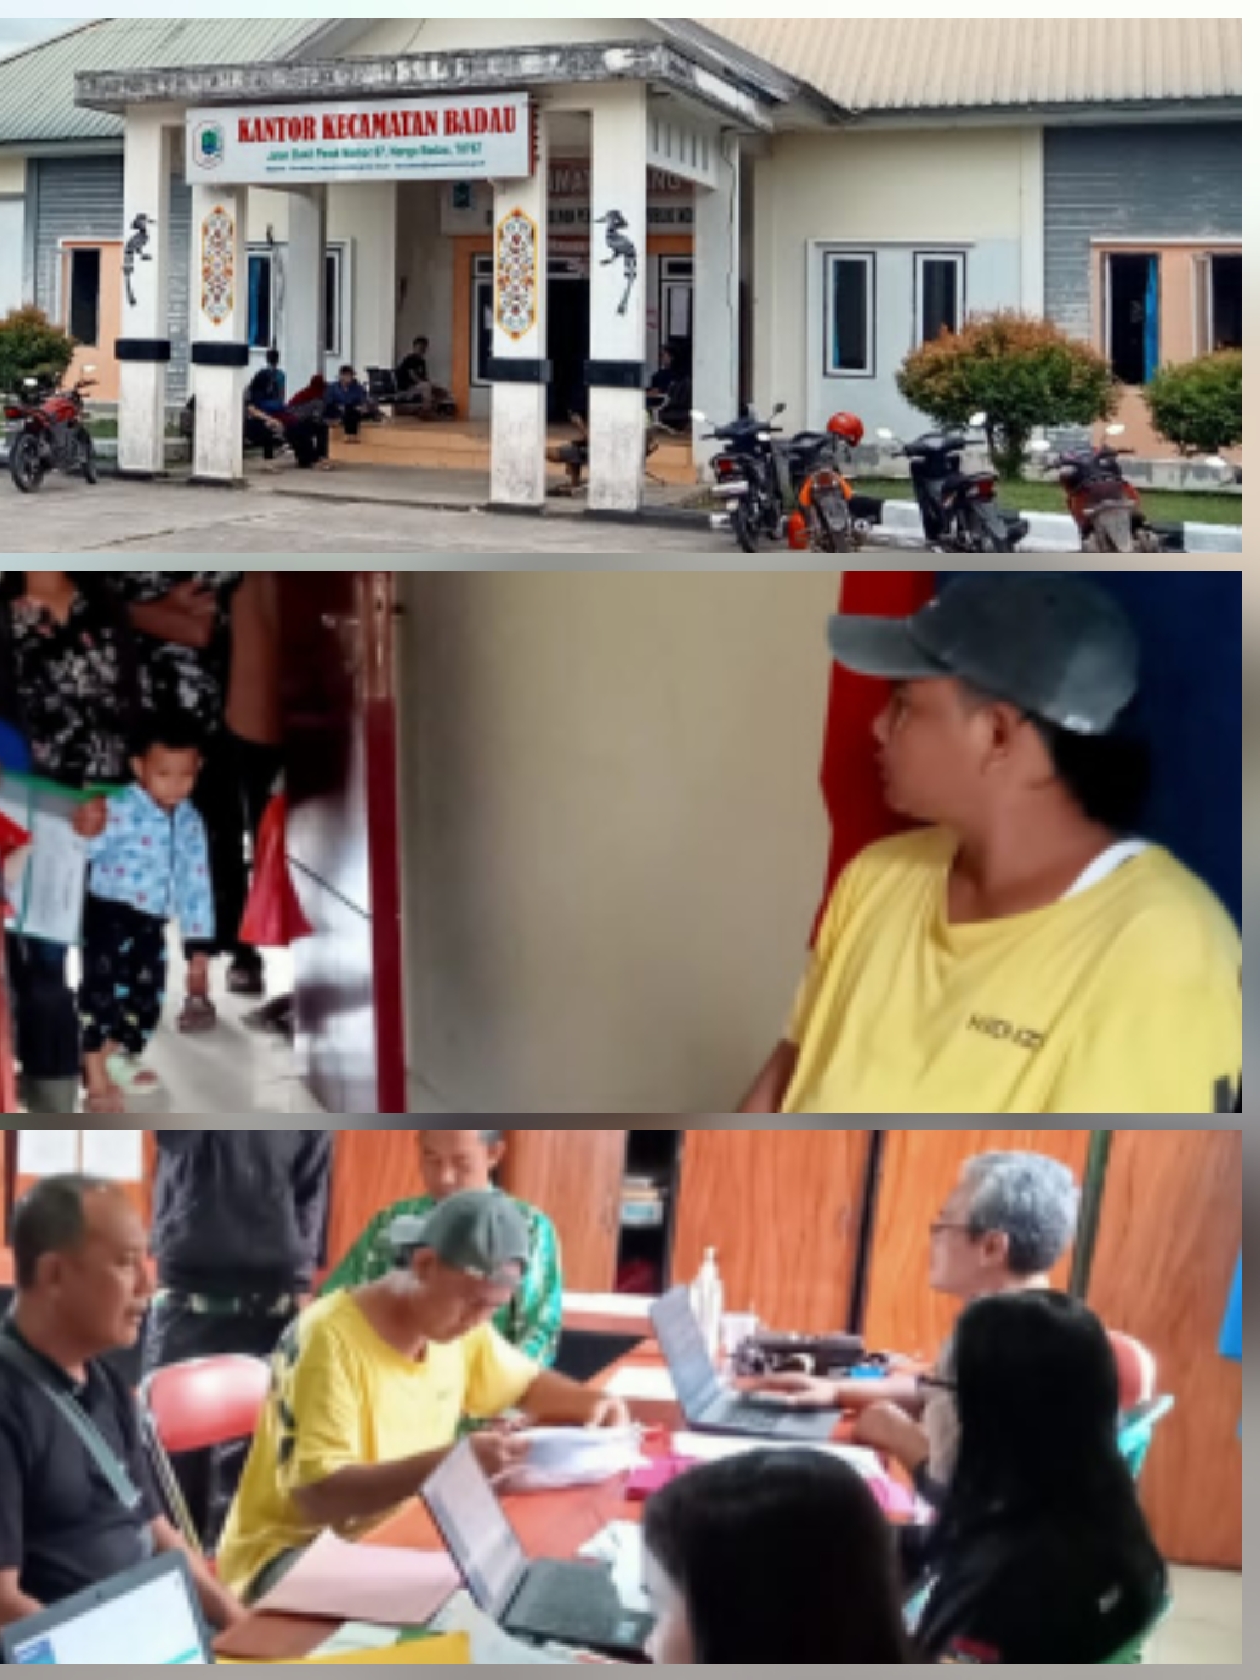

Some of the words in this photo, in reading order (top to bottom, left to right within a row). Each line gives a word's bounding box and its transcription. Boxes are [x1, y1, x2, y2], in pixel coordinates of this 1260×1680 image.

[238, 115, 317, 143] KANTOR
[322, 109, 438, 140] KECAMATAN
[443, 105, 517, 137] BADAU
